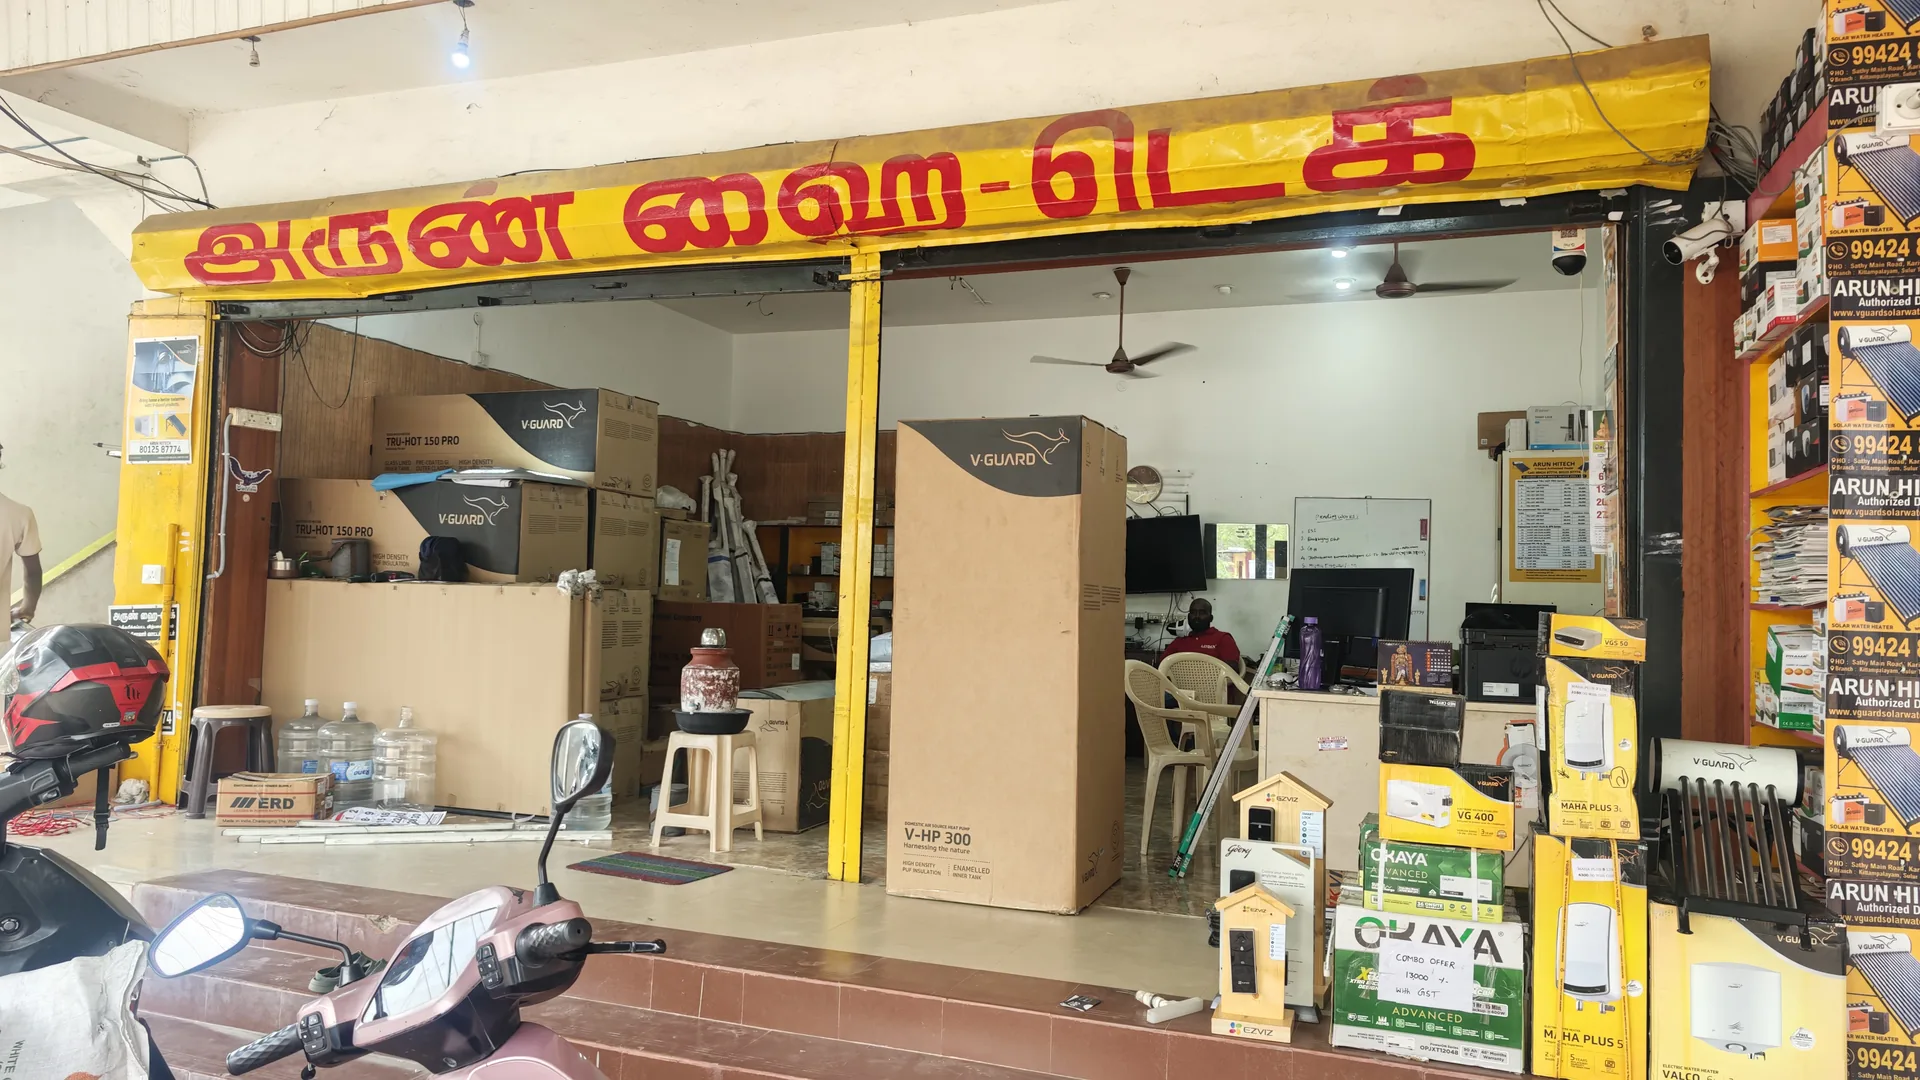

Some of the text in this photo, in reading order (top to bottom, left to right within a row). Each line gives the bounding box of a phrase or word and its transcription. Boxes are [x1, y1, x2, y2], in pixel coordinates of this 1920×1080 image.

[1852, 42, 1911, 66] 99424
[1856, 141, 1883, 150] V-GUARD
[1850, 238, 1910, 260] 99424
[1833, 279, 1890, 297] ARUN
[1858, 296, 1911, 307] Authorized
[521, 418, 564, 430] V-GUARD
[386, 436, 460, 446] TRU-HOT 150 PRO
[1854, 435, 1912, 455] 99424
[970, 453, 1036, 466] V-GUARD
[1596, 485, 1606, 493] 13
[1832, 478, 1890, 496] ARUN
[1857, 496, 1910, 506] Authorized
[438, 512, 484, 526] V-GUARD
[296, 524, 373, 537] TRU-HOT 150 PRO
[1857, 535, 1884, 543] V-GUARD
[1852, 636, 1911, 658] 99424
[1829, 678, 1889, 697] ARUN
[1855, 696, 1910, 708] Authorized
[1693, 757, 1735, 770] V-GUARD
[258, 798, 294, 809] ERD
[1561, 802, 1612, 812] MAHA PLUS
[1457, 811, 1494, 822] VG 400
[904, 828, 971, 846] V-HP 300
[903, 842, 937, 852] Harnessing
[950, 846, 970, 854] nature
[1851, 838, 1912, 862] 99424
[1371, 848, 1428, 866] OKAYA
[913, 868, 942, 876] INSULATION
[953, 864, 990, 874] ENAMELLED
[1371, 866, 1428, 879] AVANCED
[1830, 882, 1889, 902] ARUN
[1856, 902, 1910, 914] Authorized
[1355, 916, 1503, 962] OKAYA
[1777, 935, 1817, 945] V-GUAD
[1396, 954, 1456, 969] COMBO OFFER
[1418, 988, 1440, 998] GST
[1392, 1007, 1463, 1023] ADVANCED
[1244, 1026, 1274, 1036] EZVIZ
[1584, 1034, 1614, 1047] PLUS
[1617, 1040, 1624, 1049] 5
[4, 1040, 26, 1074] WHITE
[1483, 1055, 1504, 1063] Warranty
[1857, 1047, 1917, 1072] 99424
